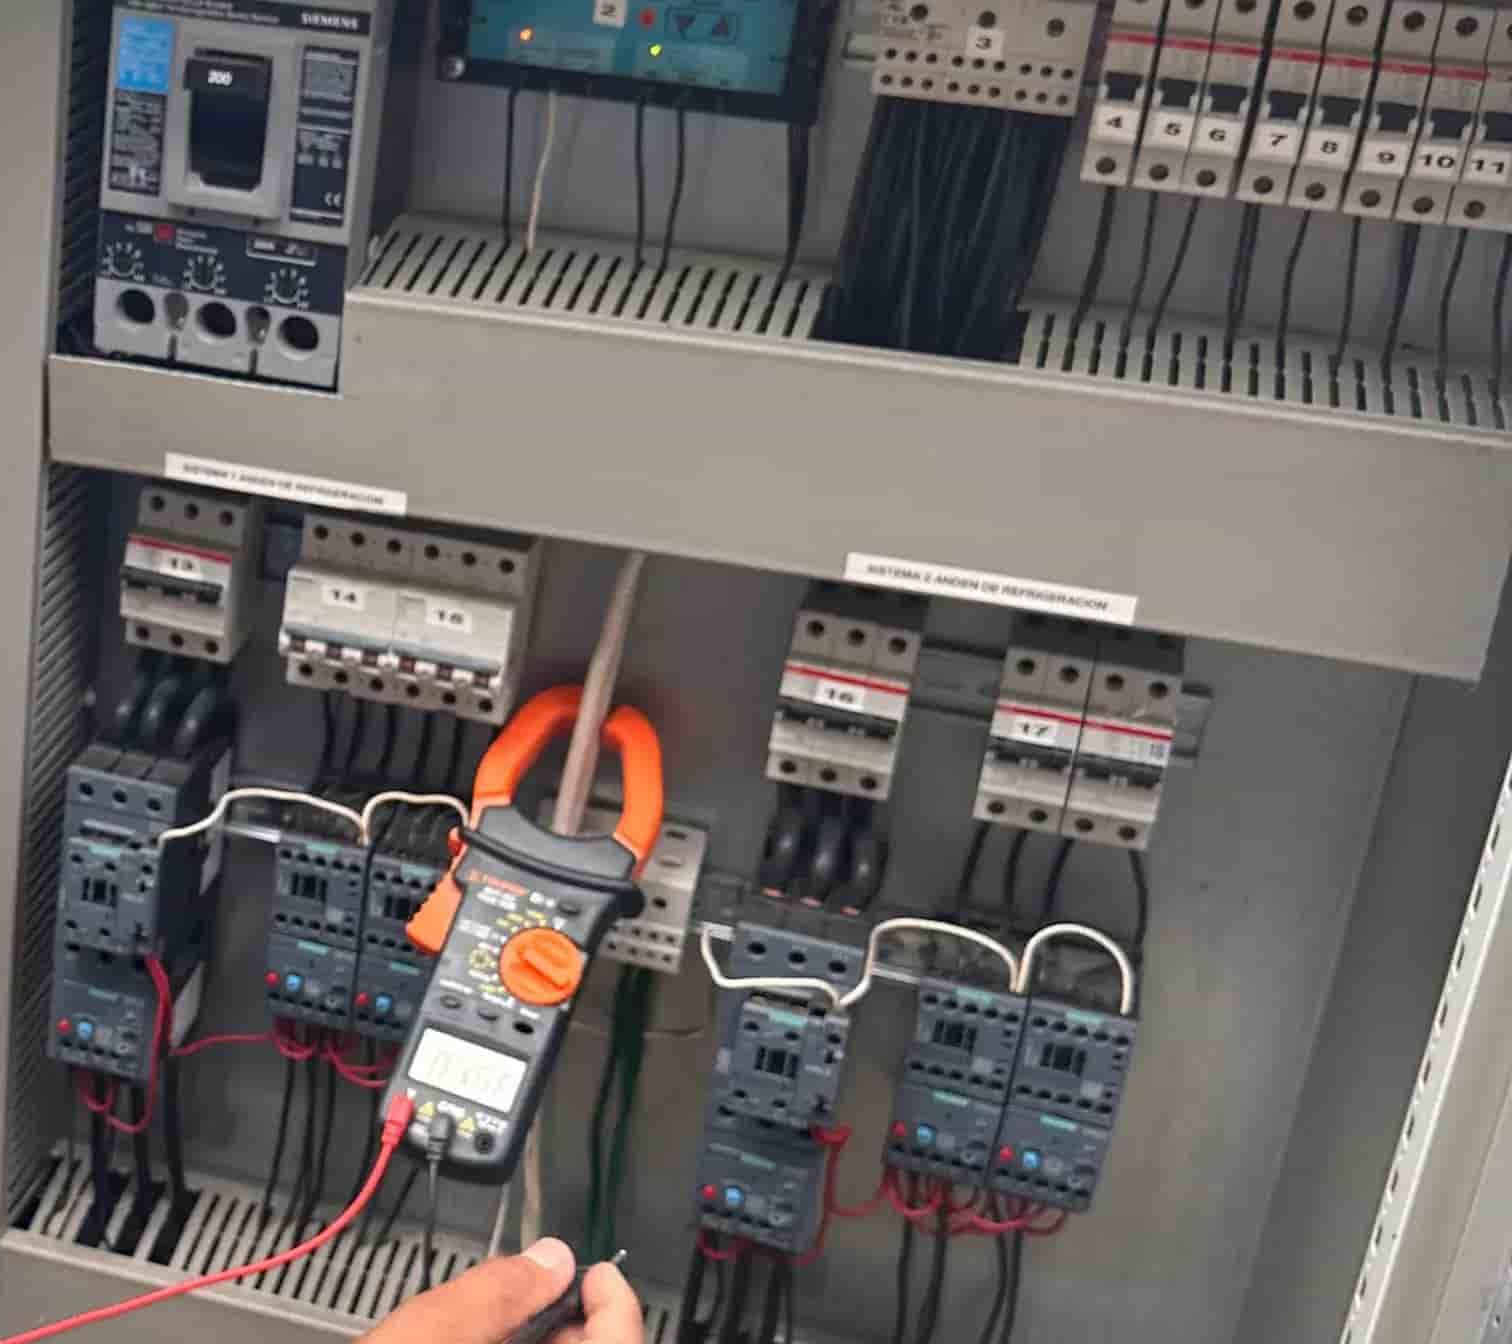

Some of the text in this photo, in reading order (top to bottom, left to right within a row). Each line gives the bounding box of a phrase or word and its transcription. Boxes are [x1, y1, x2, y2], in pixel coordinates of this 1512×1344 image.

[598, 2, 616, 17] 2
[301, 11, 359, 30] SIEMENS
[975, 36, 992, 50] 3
[1105, 115, 1123, 129] 4
[1163, 122, 1182, 136] 5
[1209, 129, 1226, 143] 6
[1270, 133, 1289, 147] 7
[1320, 140, 1339, 154] 8
[1376, 151, 1396, 164] 9
[1419, 153, 1455, 170] 10
[1471, 158, 1505, 175] 11
[866, 563, 921, 581] SISTEMA
[934, 574, 979, 592] ANDEN
[981, 581, 1001, 594] DE
[1001, 584, 1109, 611] REFRIGERACION
[332, 588, 356, 603] 14
[1021, 722, 1049, 736] 17
